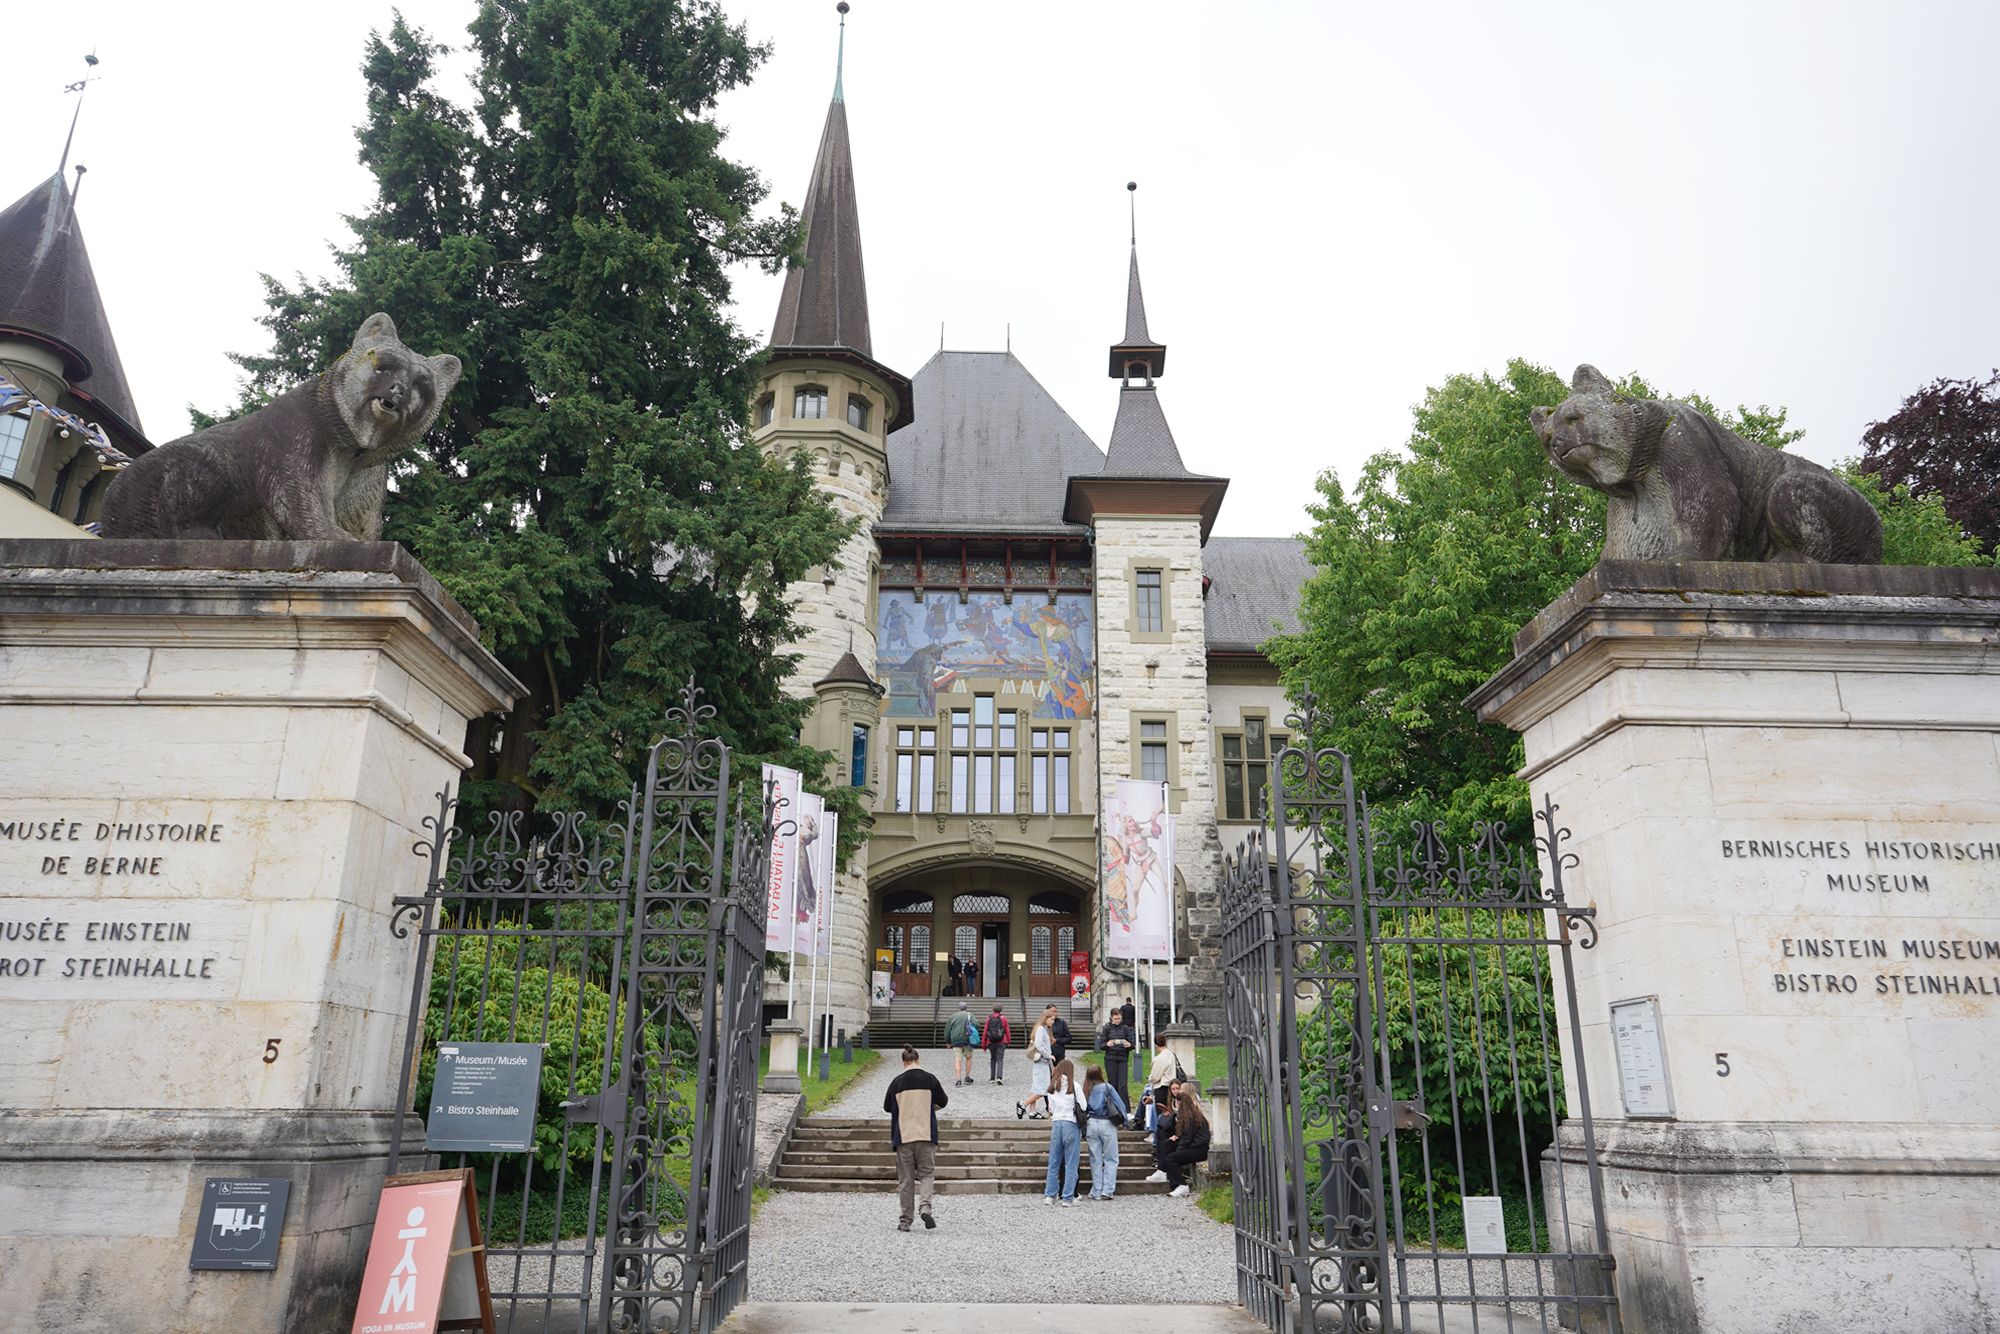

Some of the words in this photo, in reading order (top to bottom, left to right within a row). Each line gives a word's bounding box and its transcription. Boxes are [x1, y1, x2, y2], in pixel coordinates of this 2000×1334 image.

[0, 818, 82, 841] MUSÉE
[95, 822, 224, 843] D'HISTOIRE
[1721, 839, 1850, 859] BERNISCHES
[41, 856, 71, 875] DE
[84, 856, 163, 876] BERNE
[1826, 874, 1930, 893] MUSEUM
[0, 917, 69, 941] USÉE
[85, 921, 191, 942] EINSTEIN
[1781, 939, 1887, 958] EINSTEIN
[1902, 940, 2000, 960] MUSEUM
[61, 958, 215, 978] STEINHALLE
[1774, 973, 1858, 993] BISTRO
[262, 1038, 282, 1064] 5
[1715, 1052, 1731, 1078] 5
[447, 1104, 474, 1115] Bistro
[475, 1105, 519, 1116] Steinhalle
[361, 1325, 382, 1334] YOGA
[393, 1321, 426, 1331] MUSEUM
